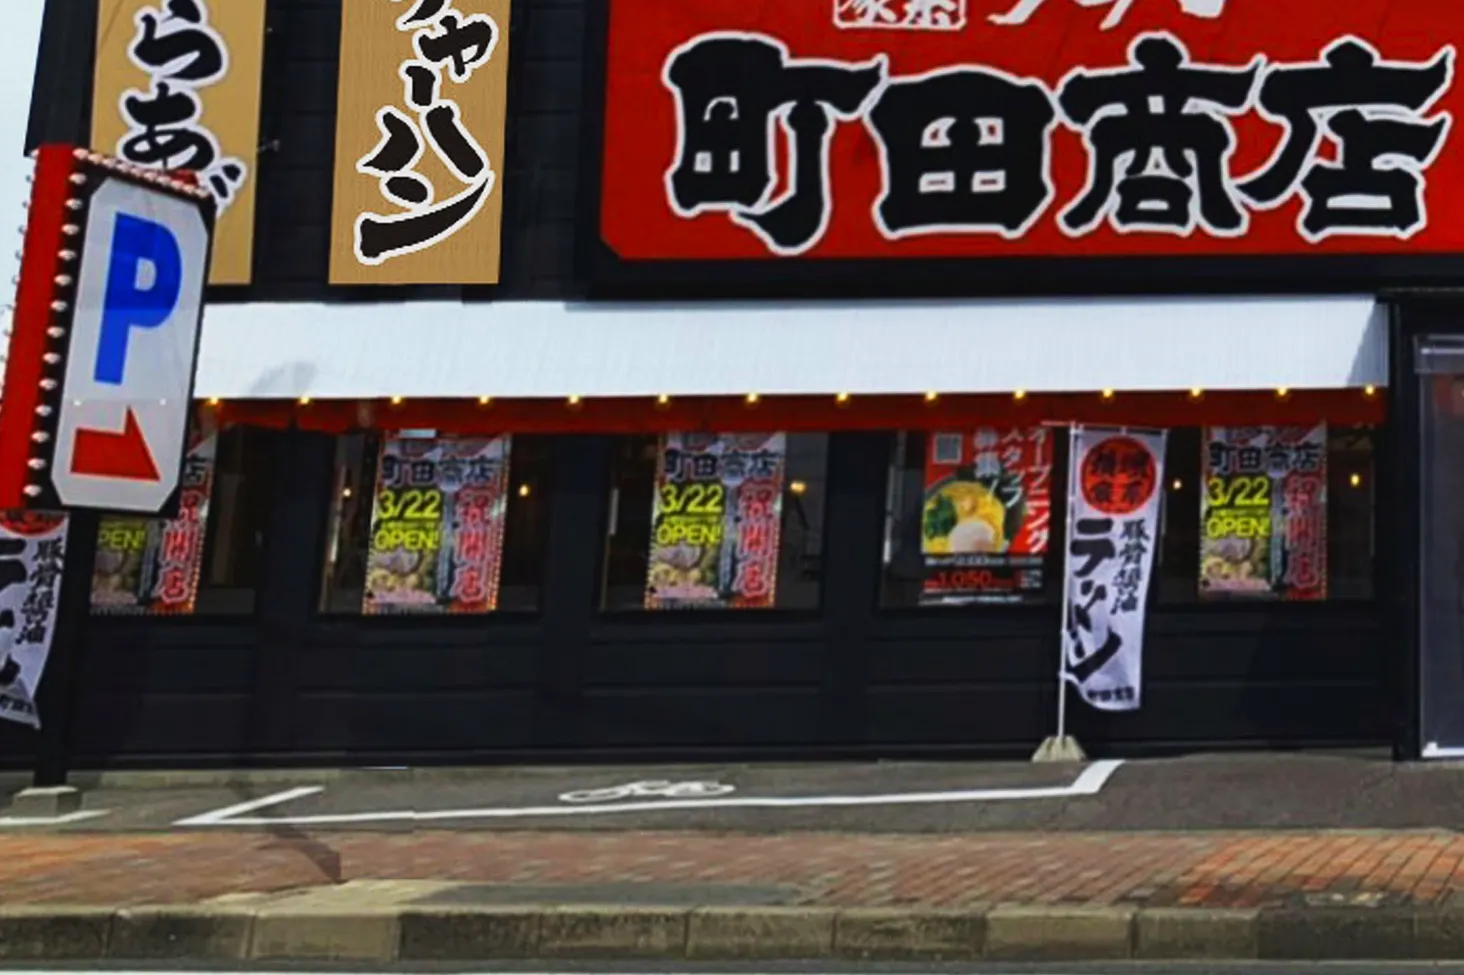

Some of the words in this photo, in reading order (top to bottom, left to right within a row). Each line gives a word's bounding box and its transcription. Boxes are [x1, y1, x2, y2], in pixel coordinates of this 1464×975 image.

[661, 30, 1456, 254] 町田商店
[93, 211, 182, 385] P
[377, 490, 441, 519] 3/22
[661, 484, 723, 513] 3/22
[1207, 476, 1269, 506] 3/22
[375, 529, 440, 551] OPEN!
[656, 524, 721, 545] OPEN!
